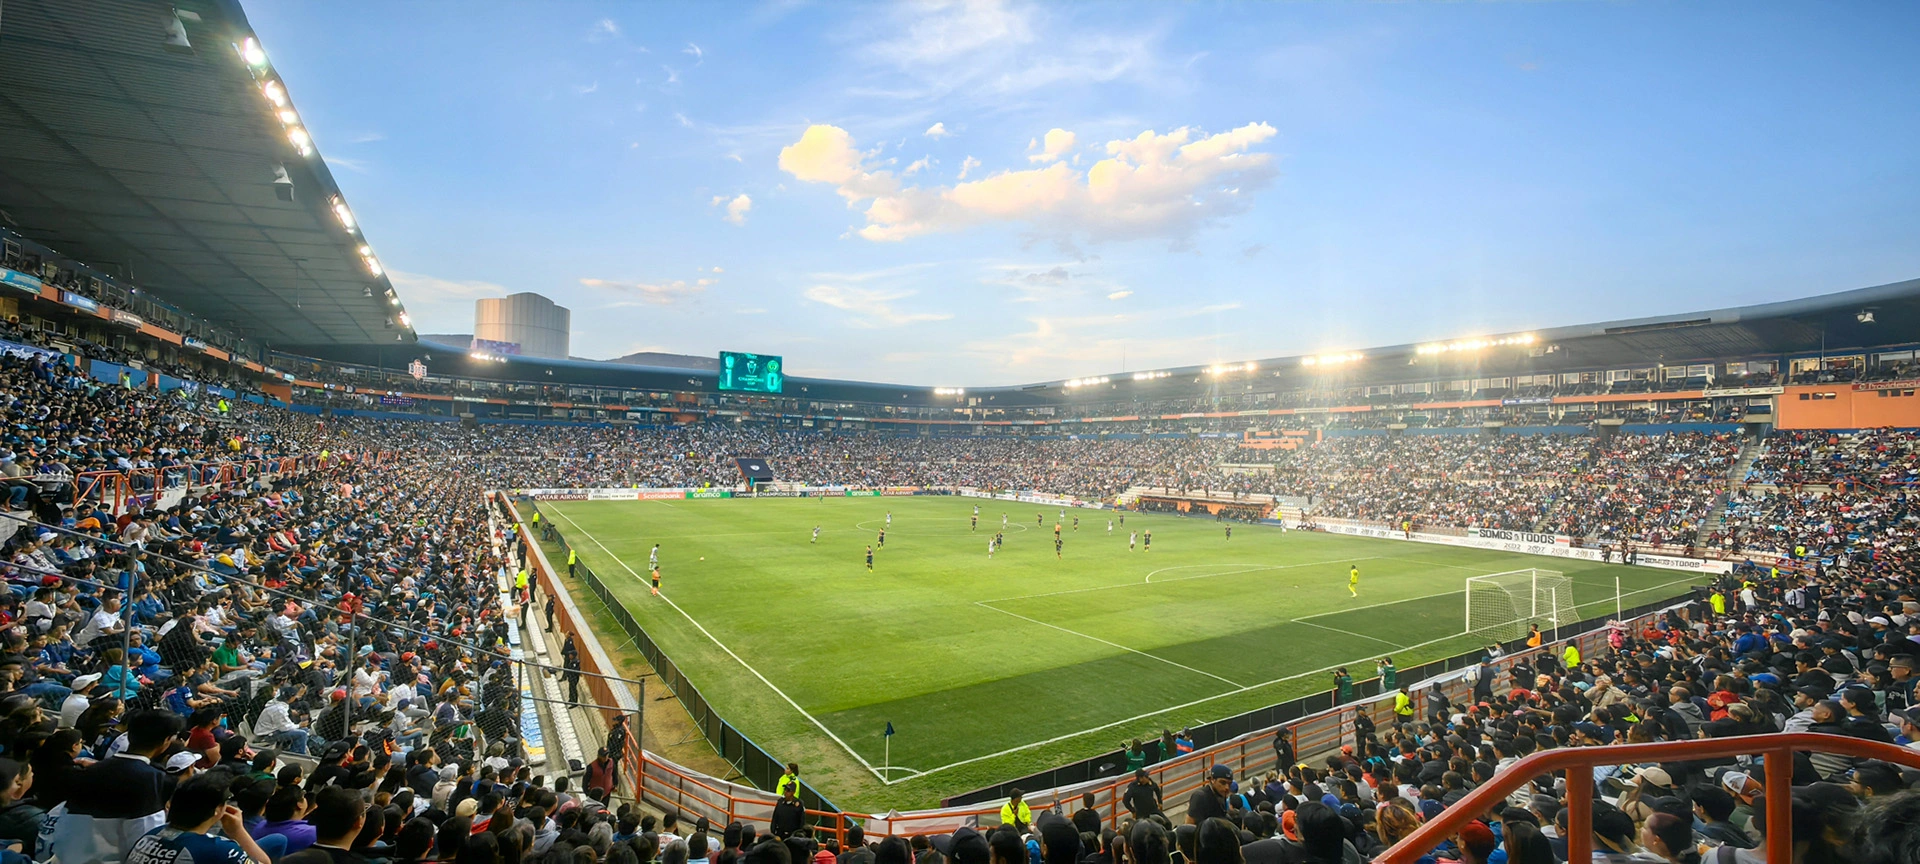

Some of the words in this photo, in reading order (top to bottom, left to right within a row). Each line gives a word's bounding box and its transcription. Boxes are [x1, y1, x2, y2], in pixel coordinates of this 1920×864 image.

[725, 369, 732, 388] 1
[767, 372, 778, 391] 0
[1479, 529, 1513, 541] SOMOS
[1521, 532, 1555, 545] TODOS
[135, 836, 178, 859] Office
